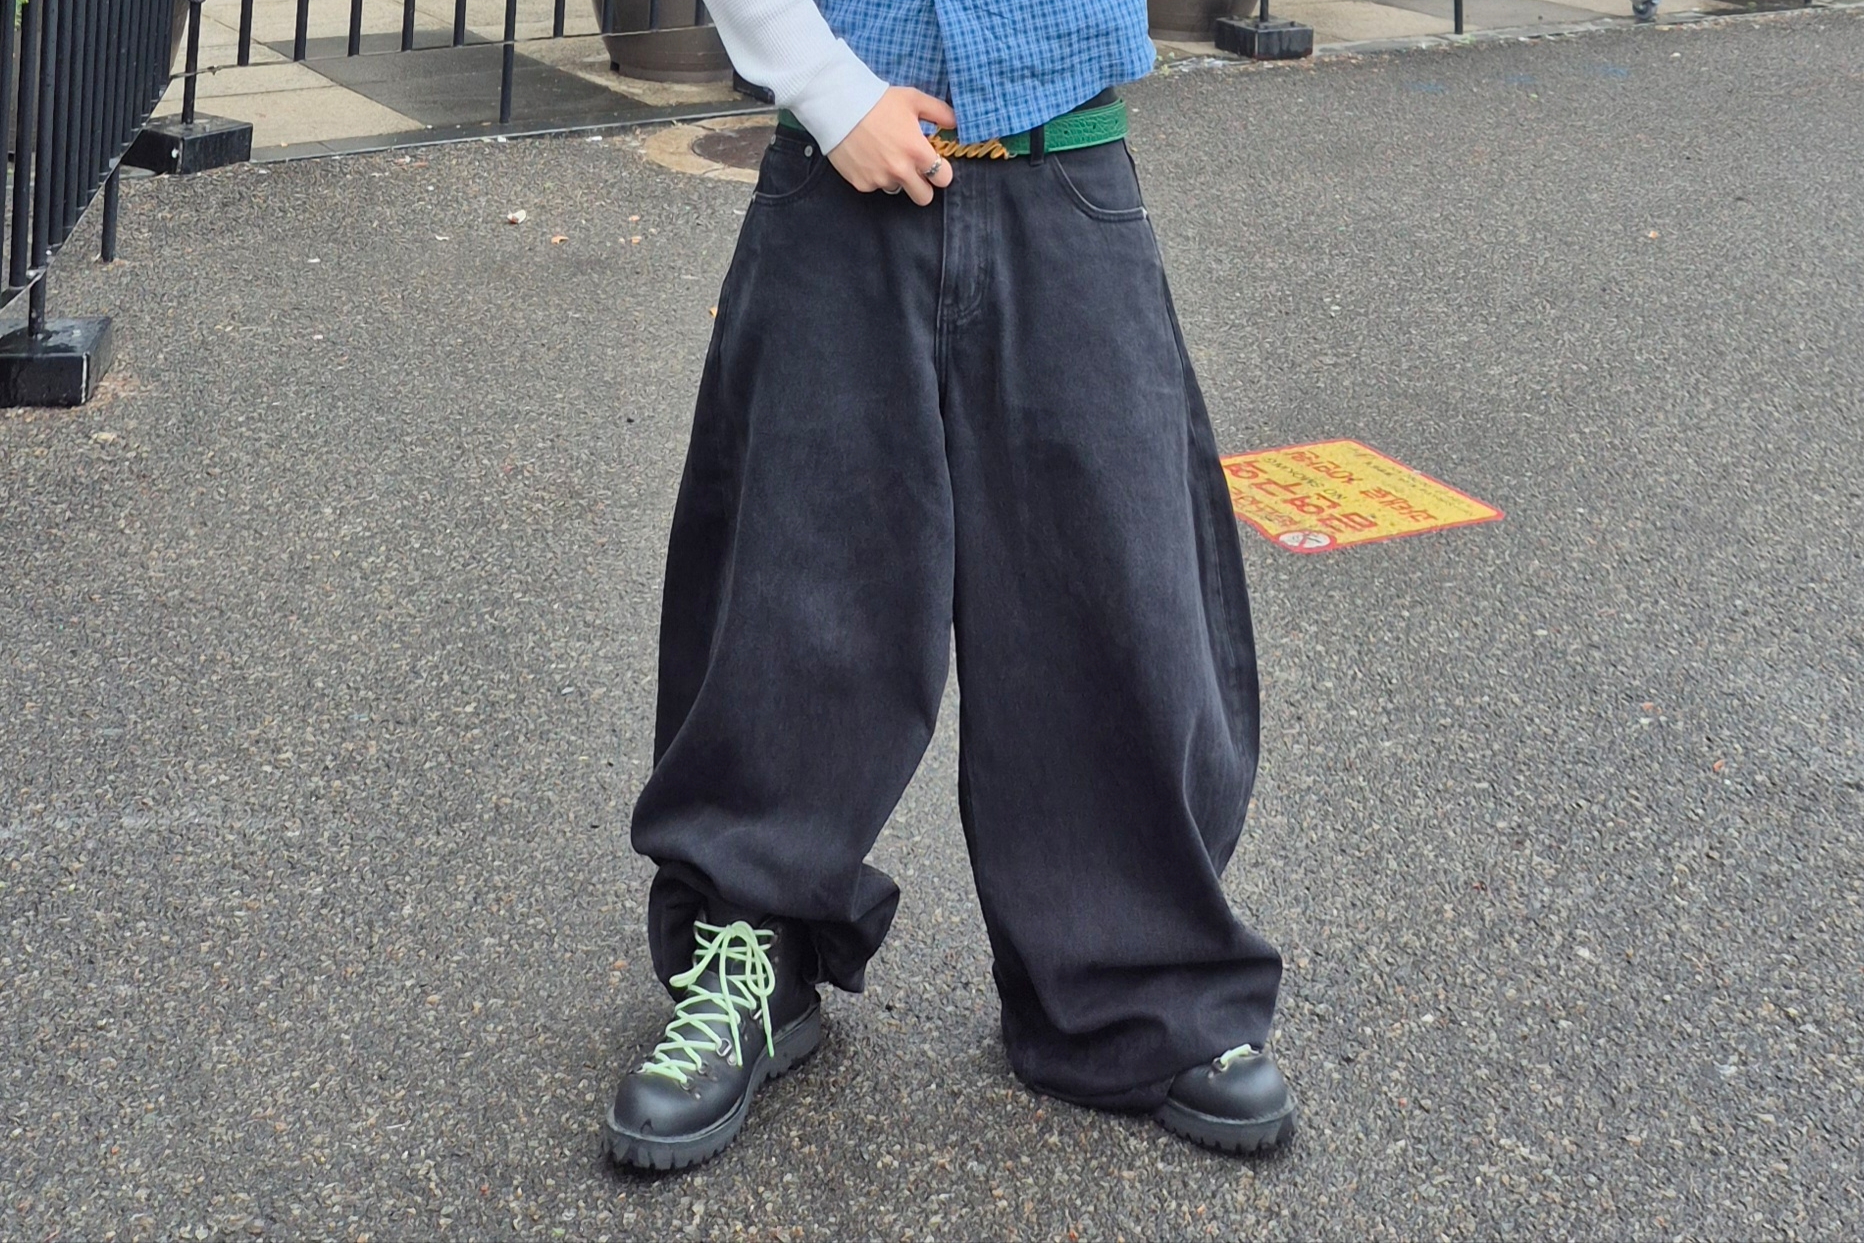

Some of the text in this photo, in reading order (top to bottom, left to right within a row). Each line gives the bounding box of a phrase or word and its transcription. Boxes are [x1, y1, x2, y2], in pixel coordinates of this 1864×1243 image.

[1224, 460, 1378, 534] 금연구역
[1263, 456, 1345, 501] NO SMOKING
